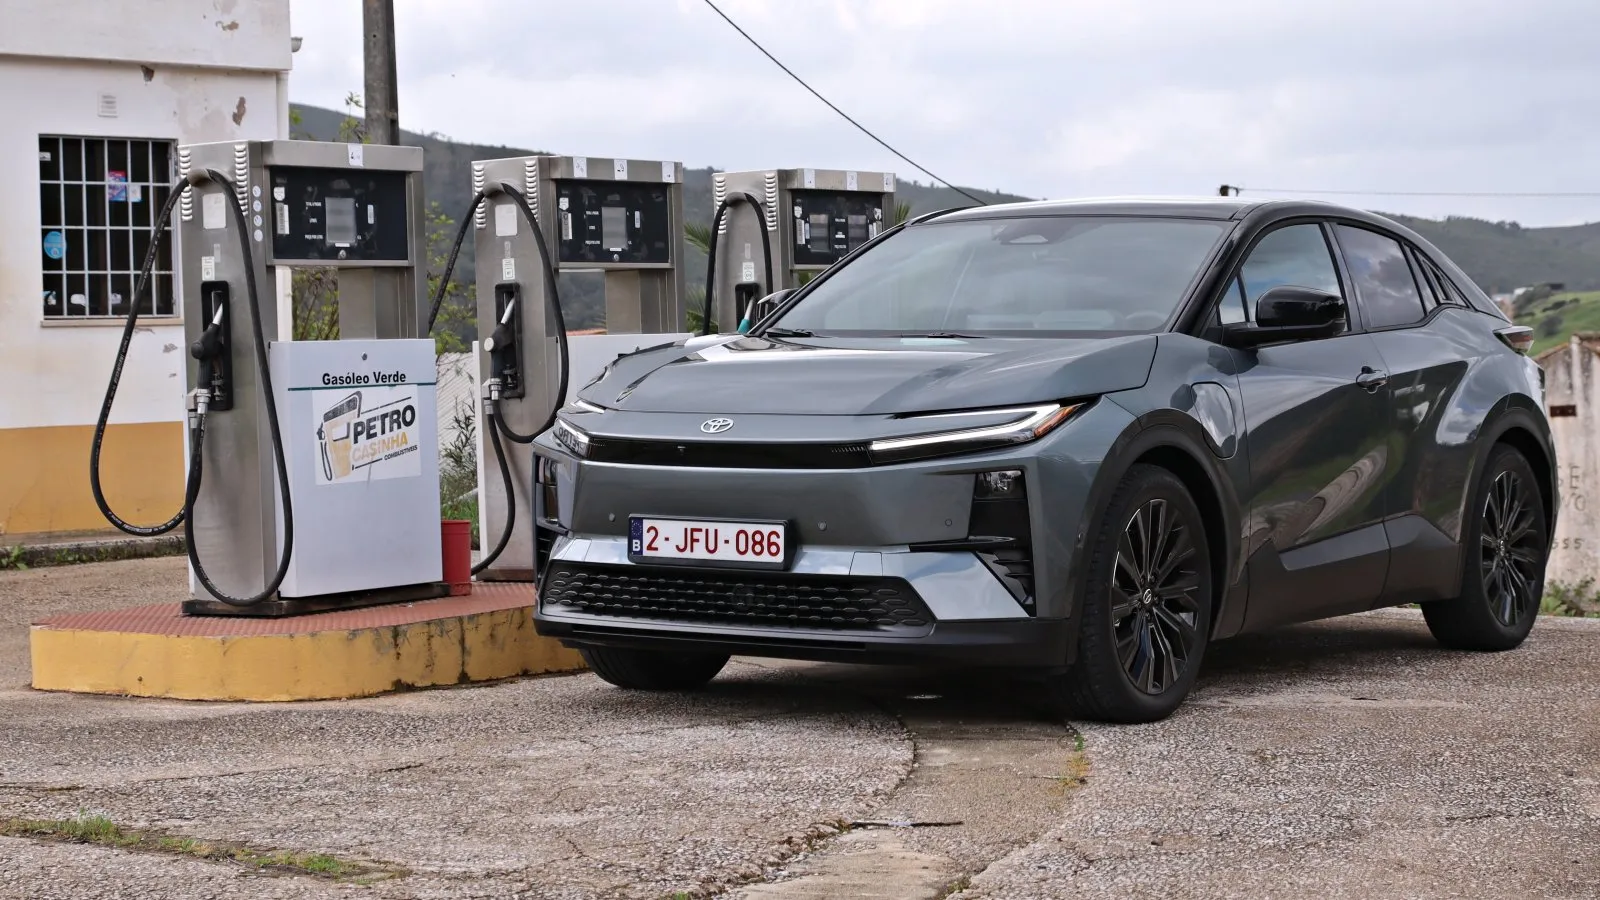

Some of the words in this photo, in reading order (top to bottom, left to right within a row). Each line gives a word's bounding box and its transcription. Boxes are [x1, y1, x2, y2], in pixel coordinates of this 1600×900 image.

[322, 372, 369, 385] Gasóleo
[373, 371, 406, 383] Verde
[353, 404, 416, 444] PETRO
[352, 432, 408, 461] CASINHA
[632, 540, 641, 552] B
[646, 525, 781, 557] 2-JFU-086
